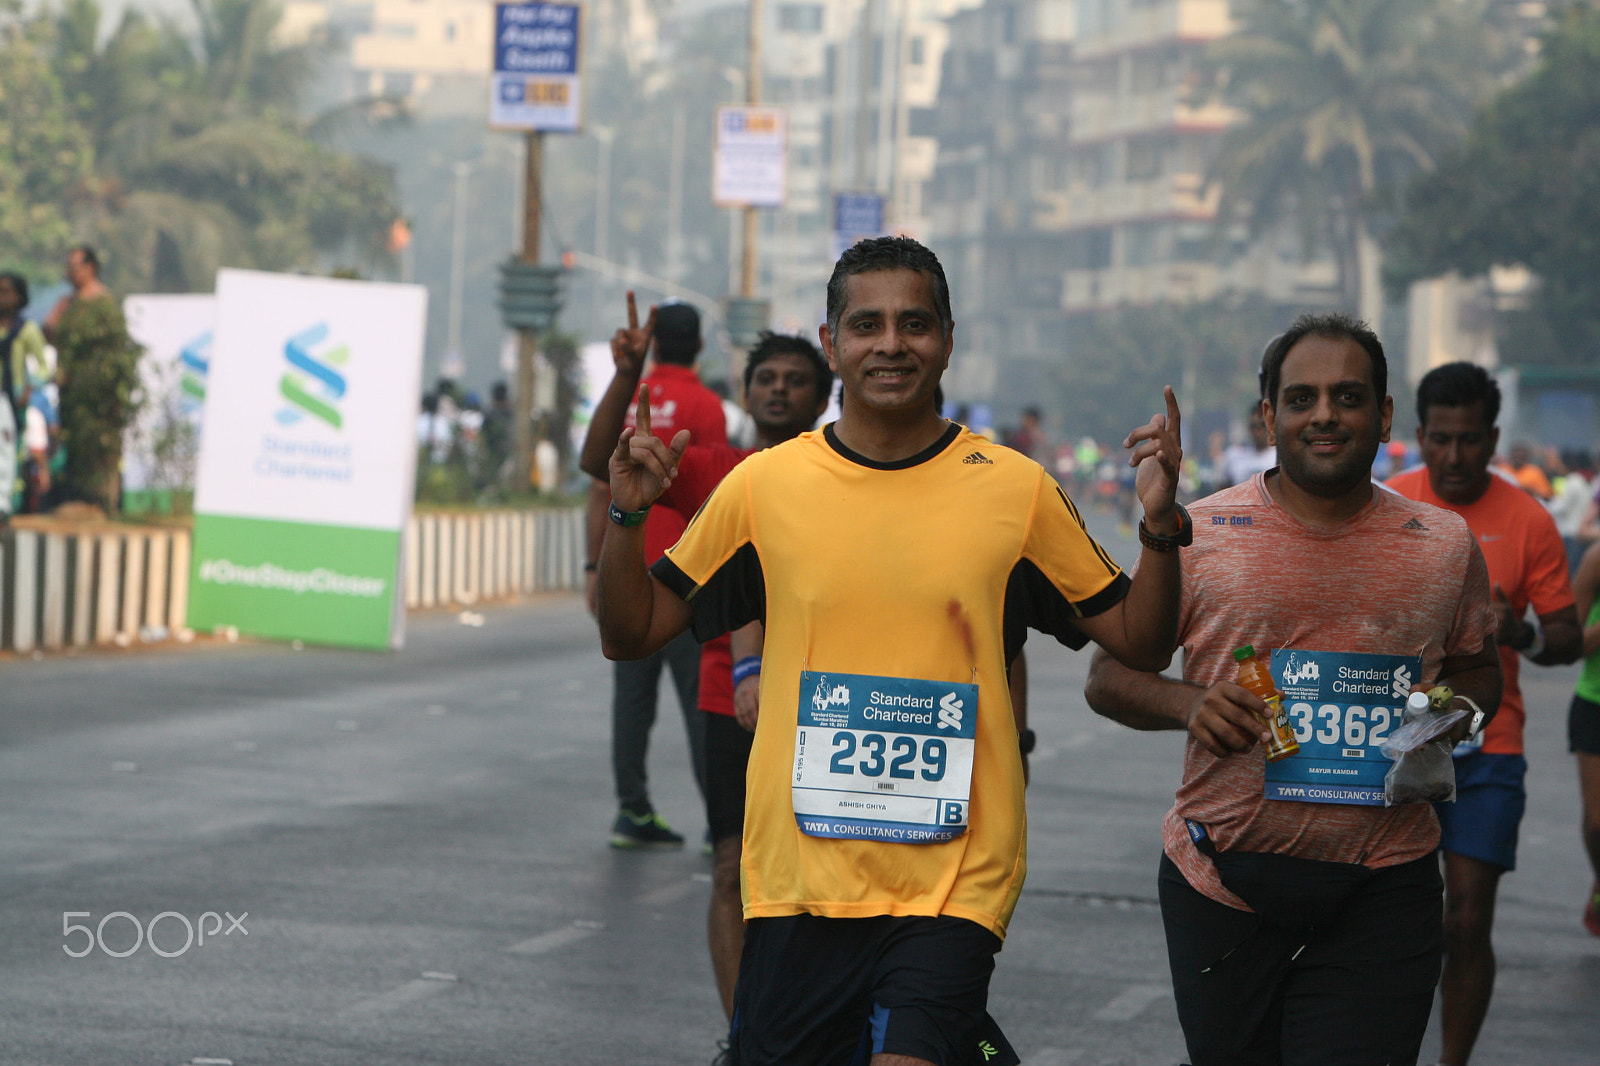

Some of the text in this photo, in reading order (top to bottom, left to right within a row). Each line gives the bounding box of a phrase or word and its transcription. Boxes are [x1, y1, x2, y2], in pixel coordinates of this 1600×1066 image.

[261, 435, 352, 459] Standard
[253, 456, 353, 482] Chartered
[1338, 666, 1389, 681] Standard
[1332, 680, 1389, 695] Chartered
[870, 690, 934, 709] Standard
[863, 706, 932, 725] Chartered
[1289, 702, 1403, 747] 3362
[829, 731, 947, 782] 2329
[1332, 768, 1359, 776] KAMDAR
[1277, 787, 1306, 797] TATA
[1308, 788, 1371, 800] CONSULTANCY
[838, 801, 865, 809] ASHISH
[944, 802, 963, 824] B
[804, 821, 953, 840] TATA CONSULTANCY SERVICES
